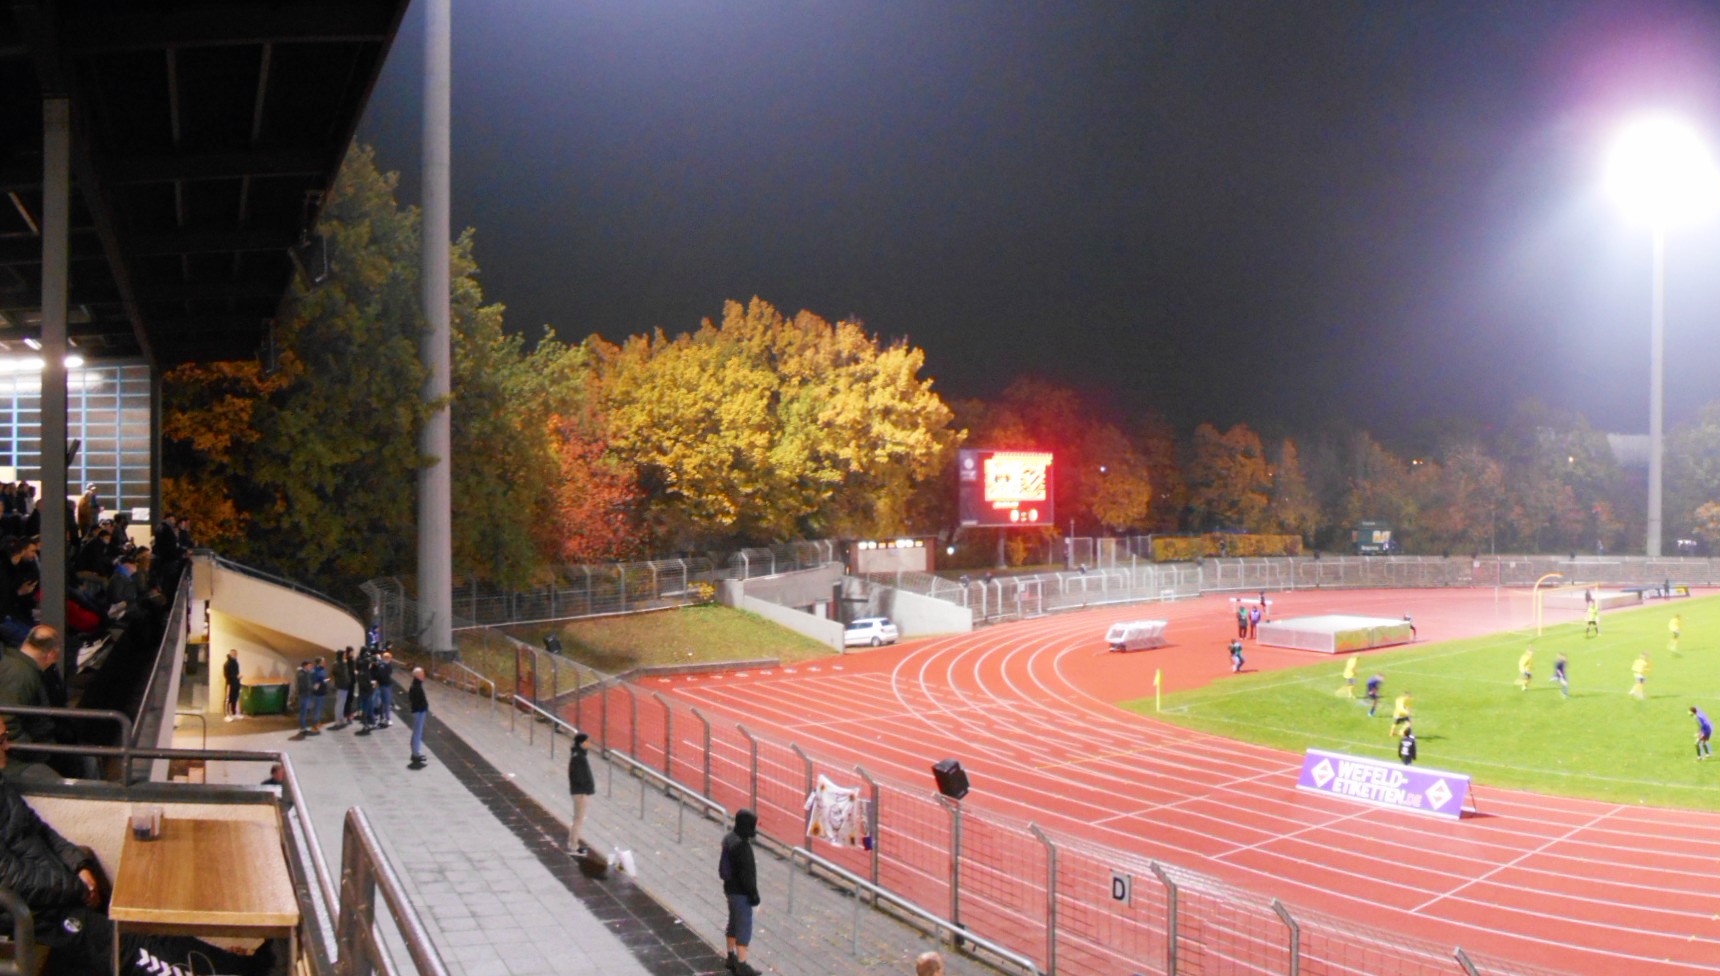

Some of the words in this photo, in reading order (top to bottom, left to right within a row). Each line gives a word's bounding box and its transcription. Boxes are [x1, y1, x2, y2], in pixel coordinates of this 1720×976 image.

[1338, 761, 1408, 788] WEFELD-
[1332, 777, 1422, 807] ETIKETTEN.DE
[1112, 876, 1126, 901] D
